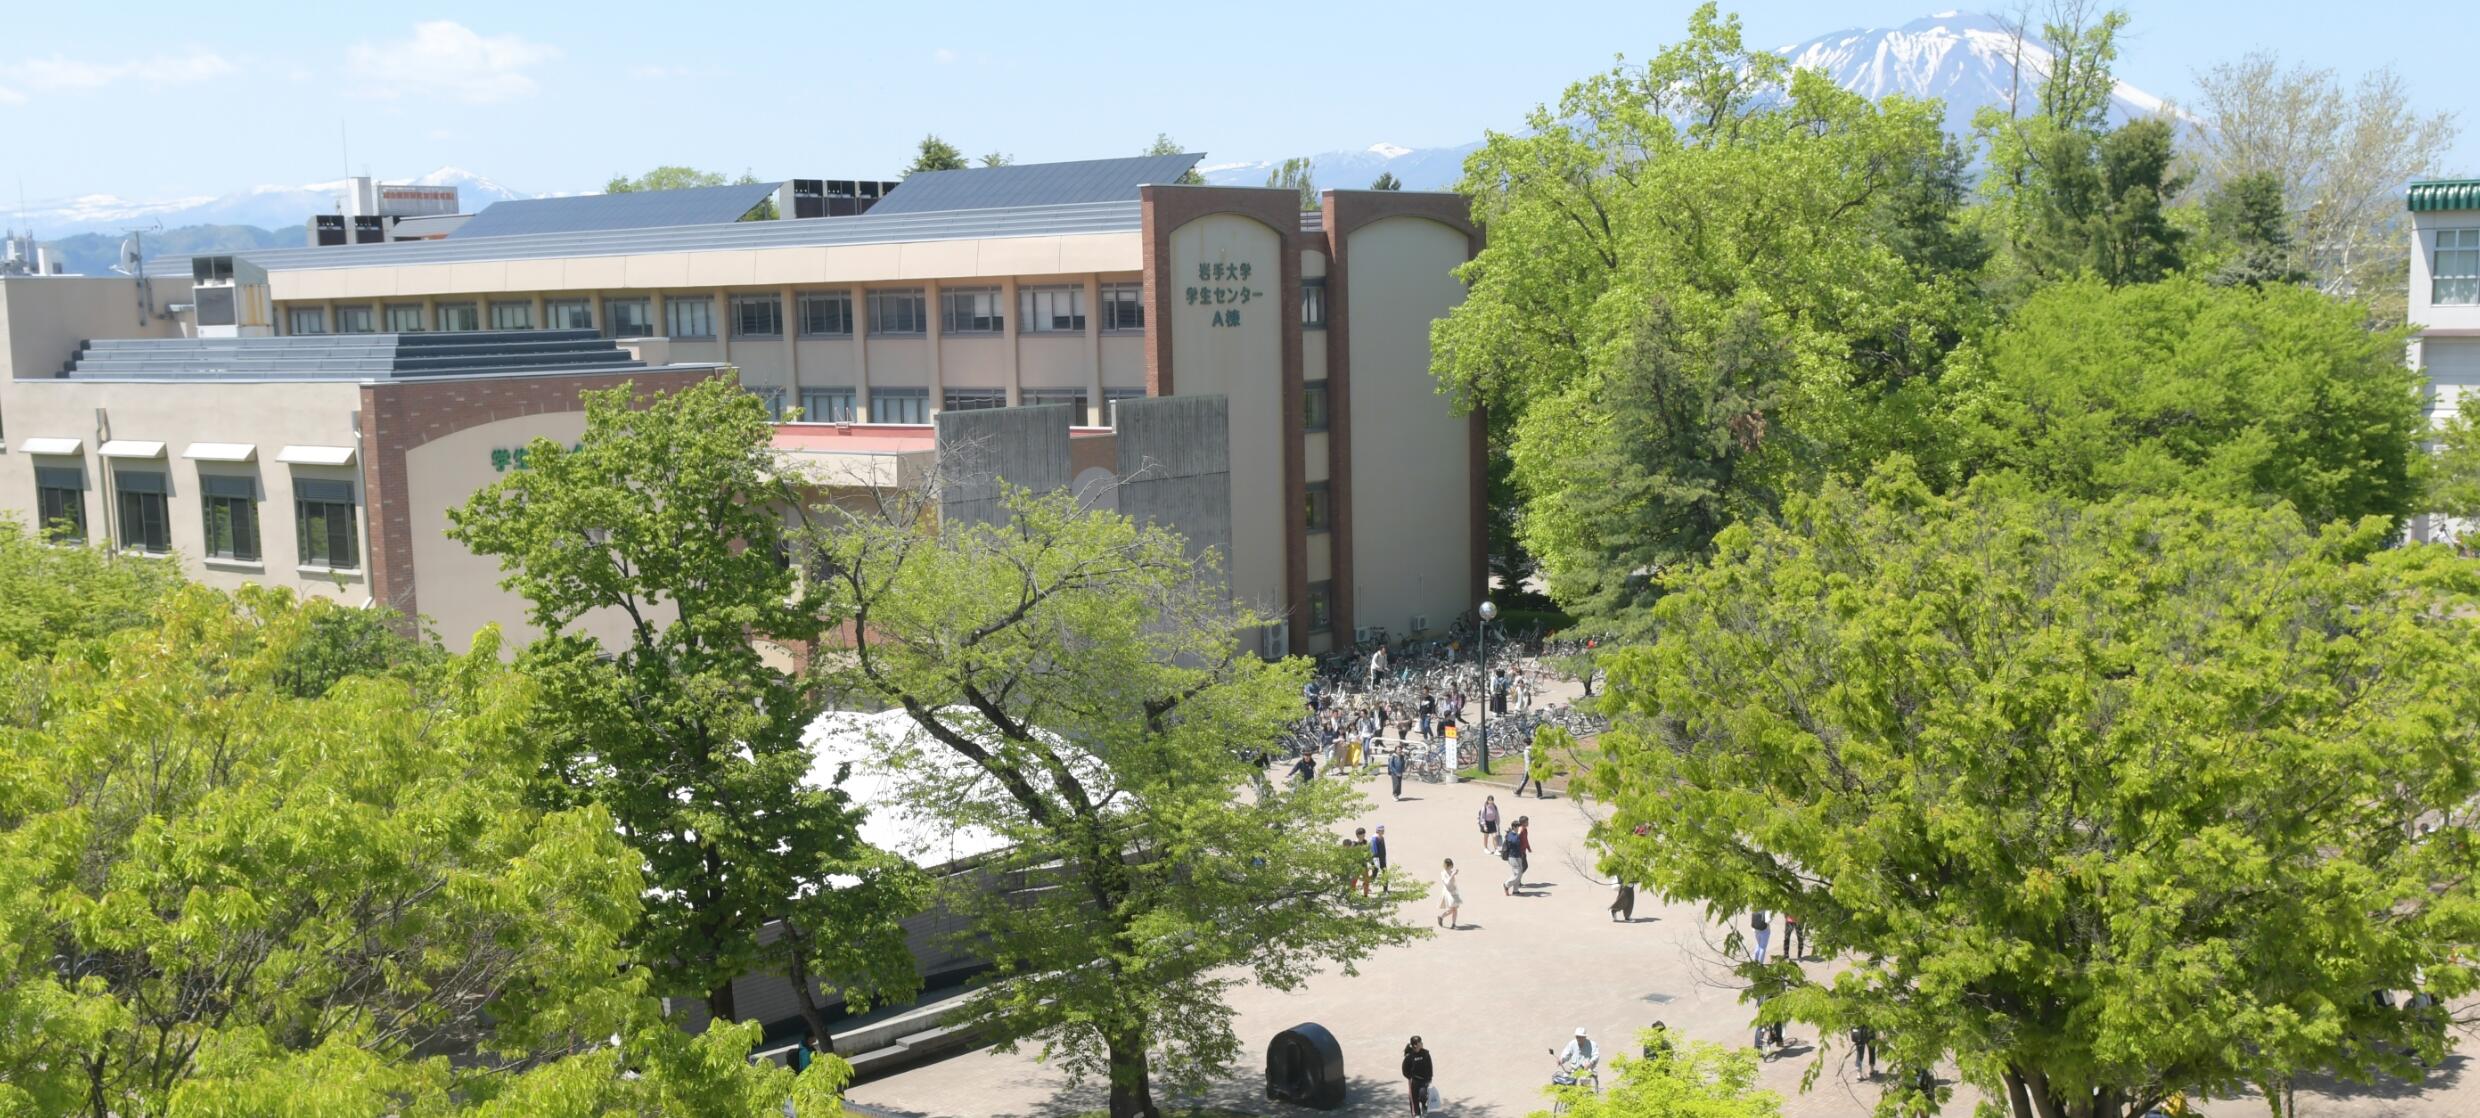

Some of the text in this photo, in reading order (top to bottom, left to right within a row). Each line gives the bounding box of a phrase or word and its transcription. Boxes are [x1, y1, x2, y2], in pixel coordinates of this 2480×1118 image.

[1198, 262, 1252, 281] 岩手大学
[1185, 286, 1263, 305] 学生センター
[1211, 309, 1241, 327] A棟
